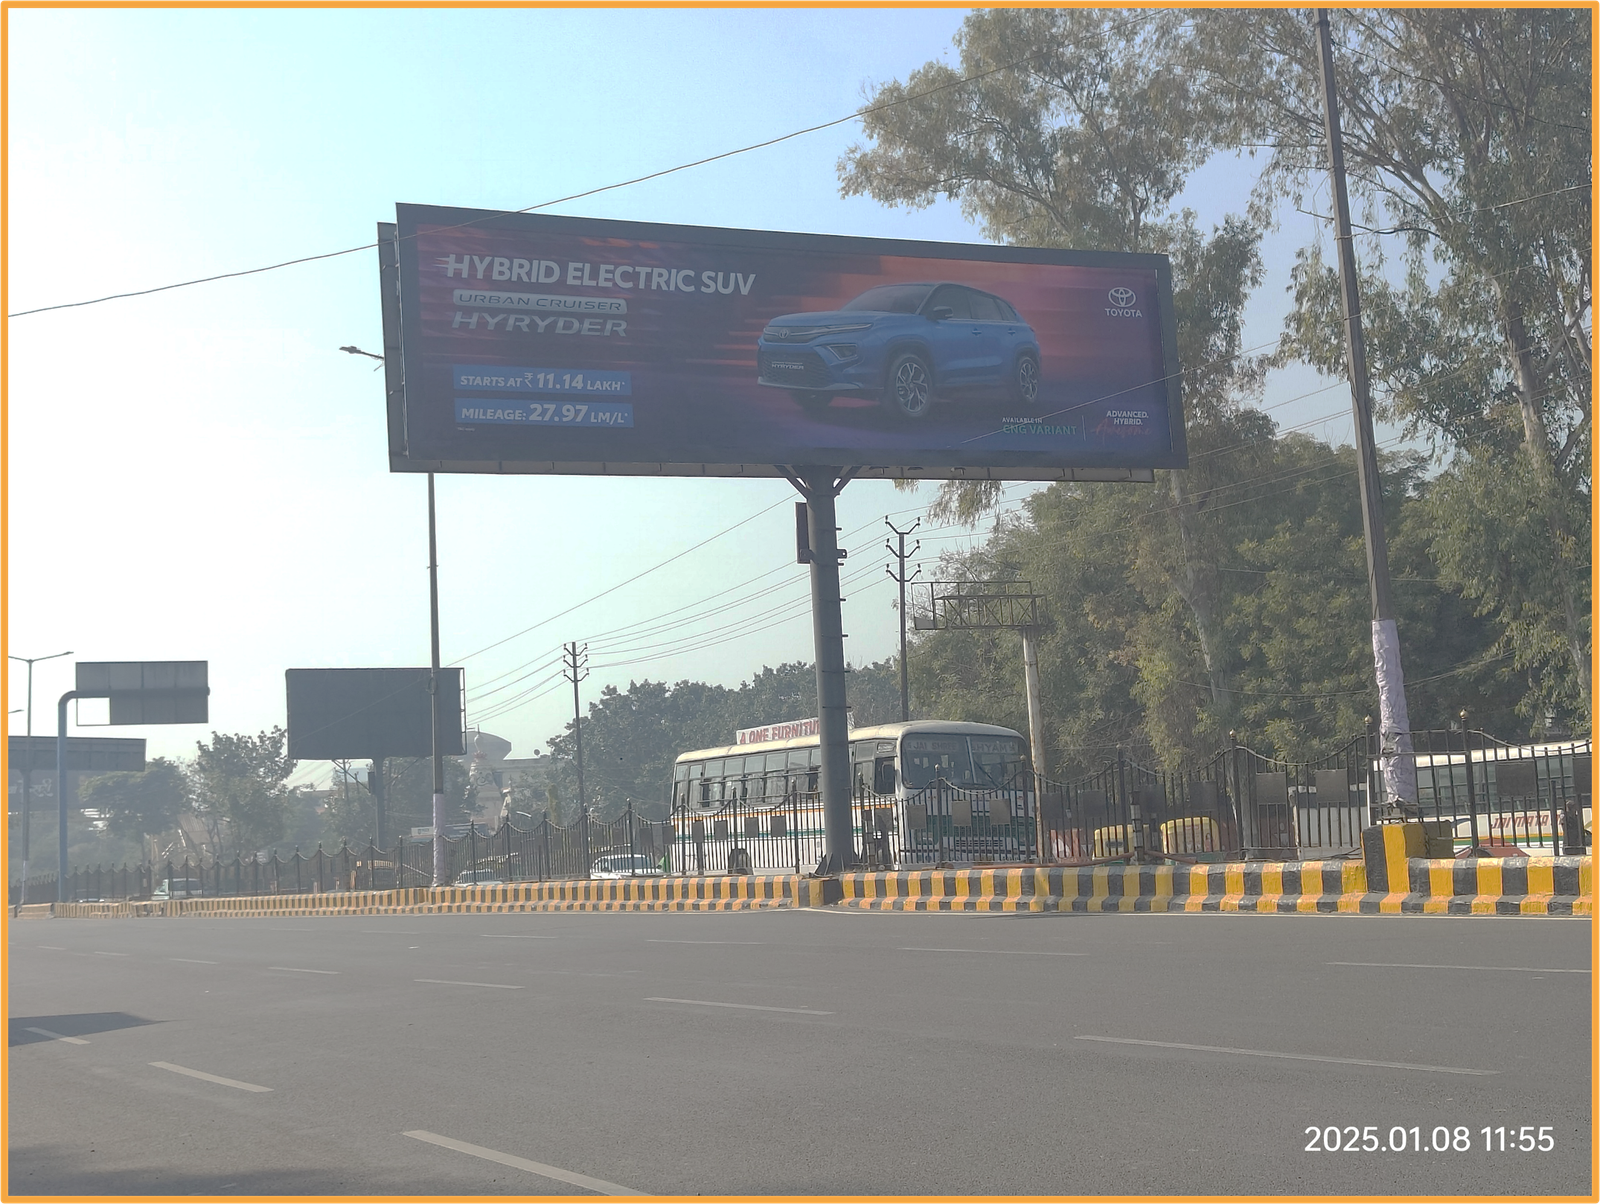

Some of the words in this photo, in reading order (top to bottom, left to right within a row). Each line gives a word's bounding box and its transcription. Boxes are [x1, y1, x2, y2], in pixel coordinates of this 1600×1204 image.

[444, 254, 561, 284] HYBRID
[566, 262, 697, 292] ELECTRIC
[700, 270, 757, 295] SUV
[459, 293, 530, 306] URBAN
[536, 297, 622, 311] CRUISER
[1104, 308, 1143, 318] TOYOTA
[451, 311, 627, 337] HYRYDER
[460, 375, 505, 387] STARTS
[507, 377, 523, 387] AT
[461, 407, 527, 421] MILEAGE:
[529, 403, 588, 422] 27.97
[1106, 411, 1149, 419] ADVANCED.
[1113, 418, 1143, 426] HYBRID.
[1003, 425, 1027, 434] CNG
[1029, 425, 1077, 435] VARIANT
[739, 732, 747, 744] A
[748, 727, 769, 743] ONE
[913, 741, 928, 750] JAI
